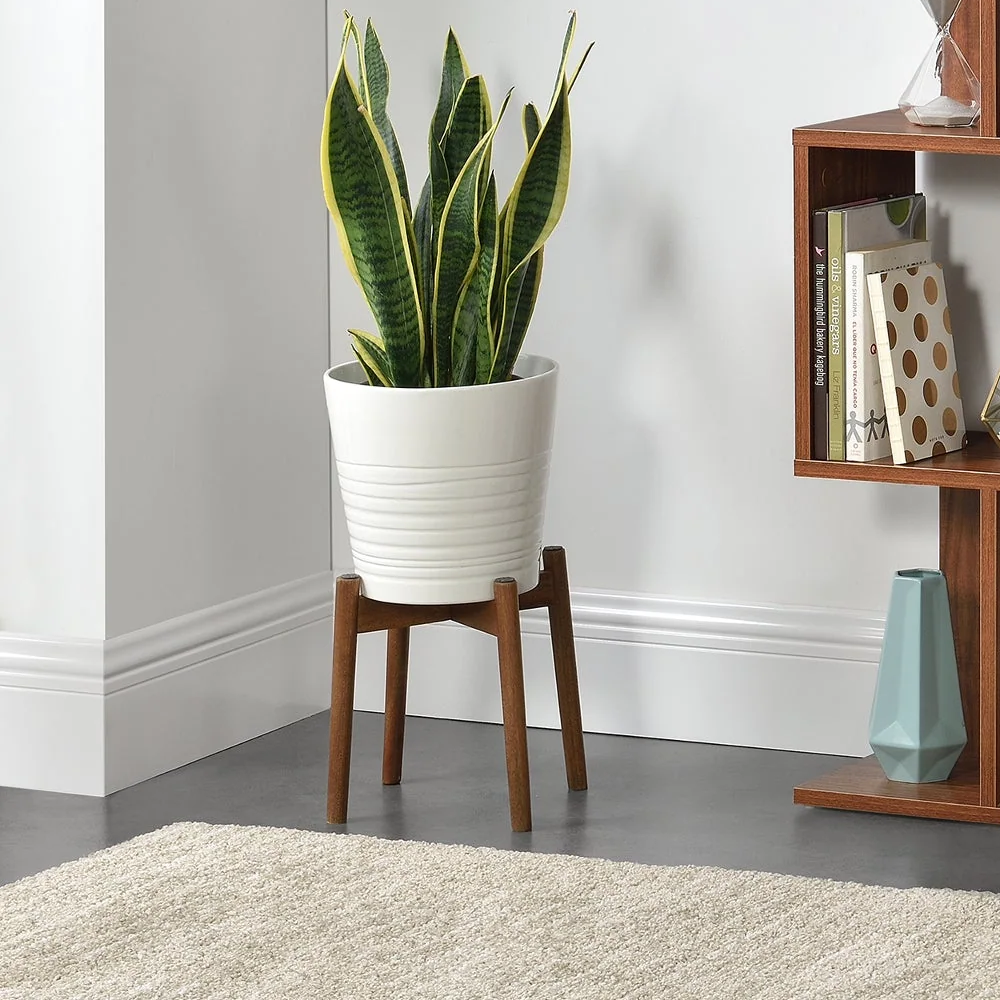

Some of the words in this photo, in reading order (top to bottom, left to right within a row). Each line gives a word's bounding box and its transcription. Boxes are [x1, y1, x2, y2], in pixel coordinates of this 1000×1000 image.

[815, 263, 826, 276] the
[831, 257, 842, 282] oils
[814, 278, 826, 326] hummingbird
[831, 285, 842, 294] &
[829, 295, 842, 355] vinegars
[815, 328, 826, 353] bakery
[815, 355, 827, 386] kagebog
[833, 370, 841, 384] Liz
[852, 360, 858, 370] NO
[833, 385, 841, 420] Franklin
